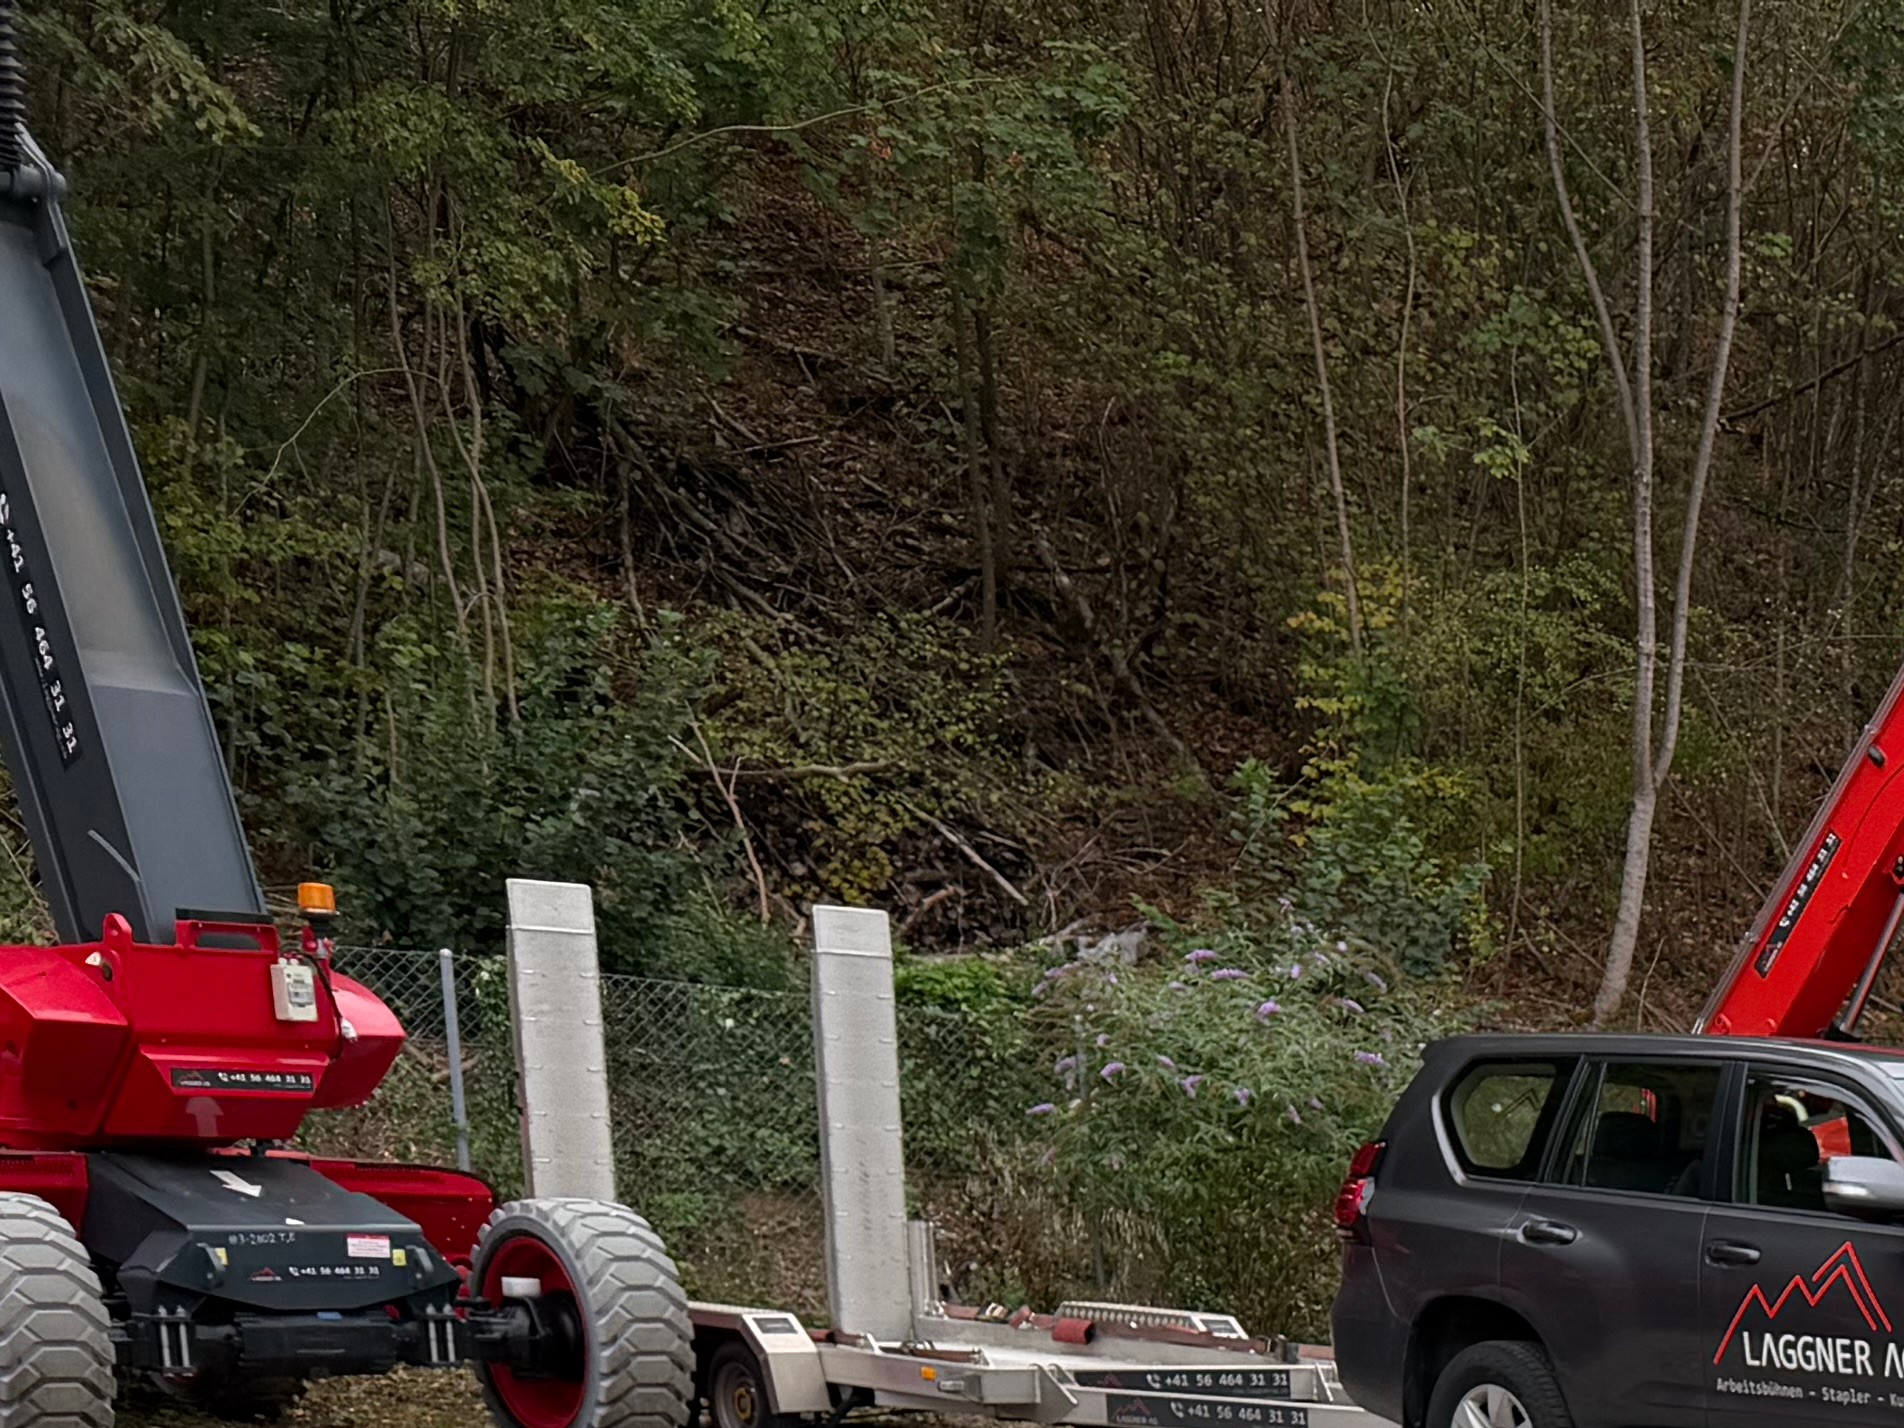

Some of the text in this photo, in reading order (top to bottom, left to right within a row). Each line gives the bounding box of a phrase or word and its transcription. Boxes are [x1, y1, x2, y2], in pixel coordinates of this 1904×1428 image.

[50, 679, 65, 712] 31
[61, 721, 78, 754] 31
[1742, 1331, 1875, 1377] LAGGNER
[1165, 1372, 1289, 1387] +41 56 464 31 31
[1716, 1377, 1804, 1399] Arbeitsbühnen
[1821, 1386, 1872, 1406] Stapler
[1187, 1405, 1307, 1426] +41 56 464 31 31
